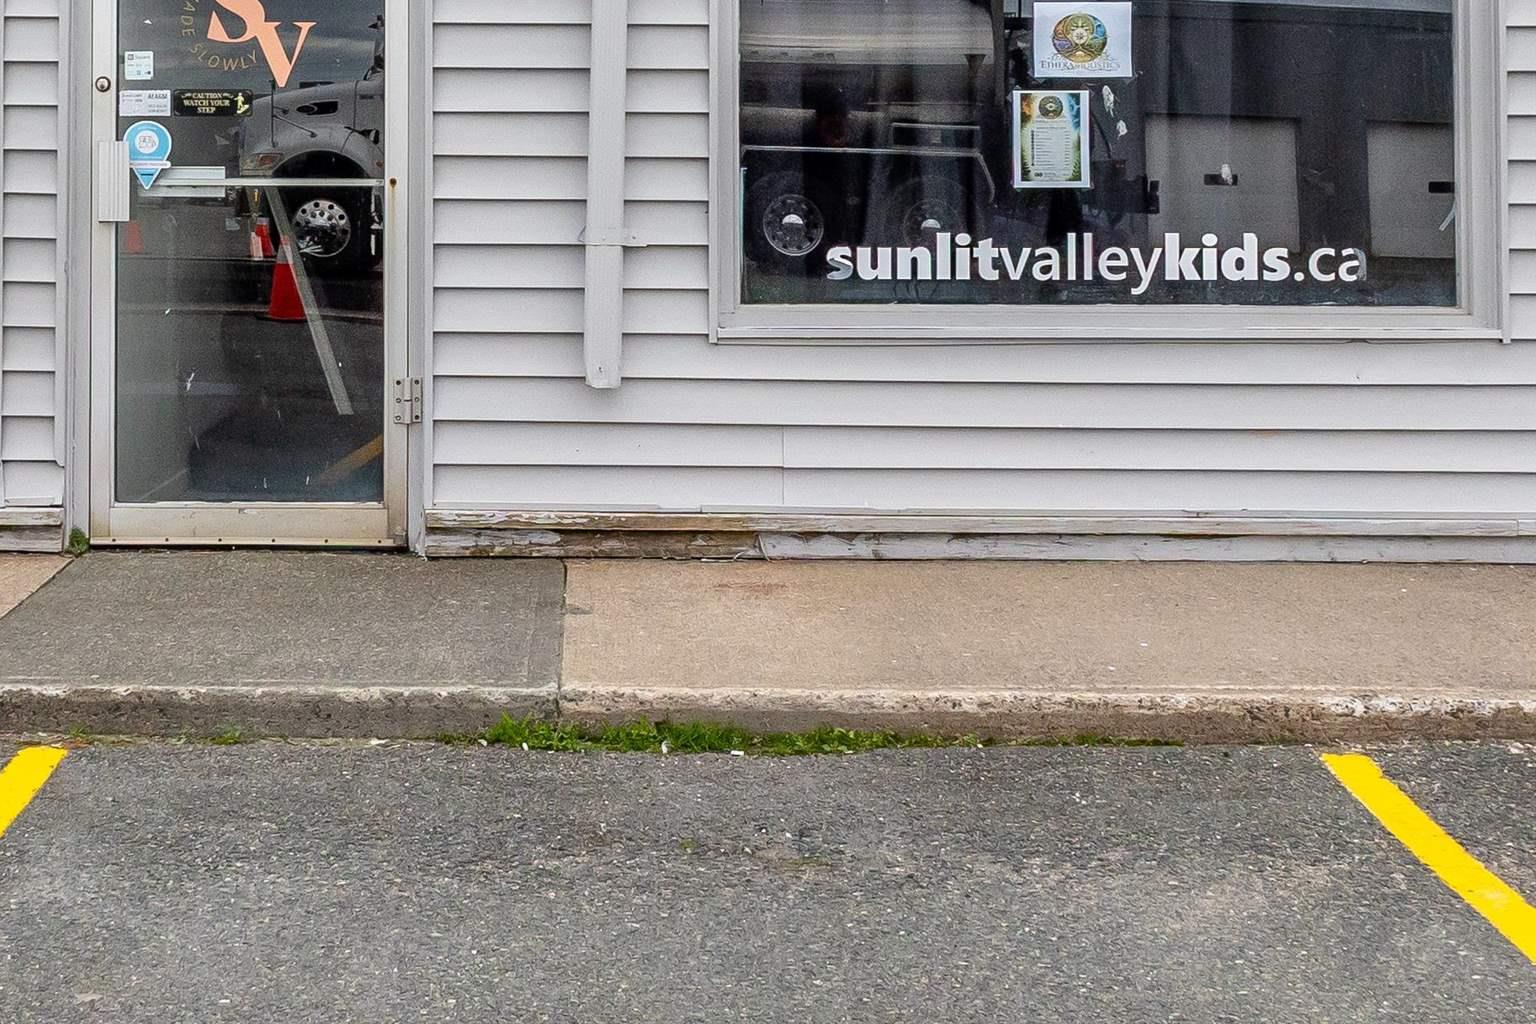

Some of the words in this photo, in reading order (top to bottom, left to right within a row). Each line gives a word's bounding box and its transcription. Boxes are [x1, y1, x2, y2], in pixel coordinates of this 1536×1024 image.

[190, 43, 257, 71] SLOWLY
[192, 92, 223, 100] CAUTION
[183, 99, 209, 107] WATCH
[210, 99, 231, 107] YOUR
[197, 106, 217, 114] STEP
[825, 232, 1368, 295] sunlitvalleykids.ca
